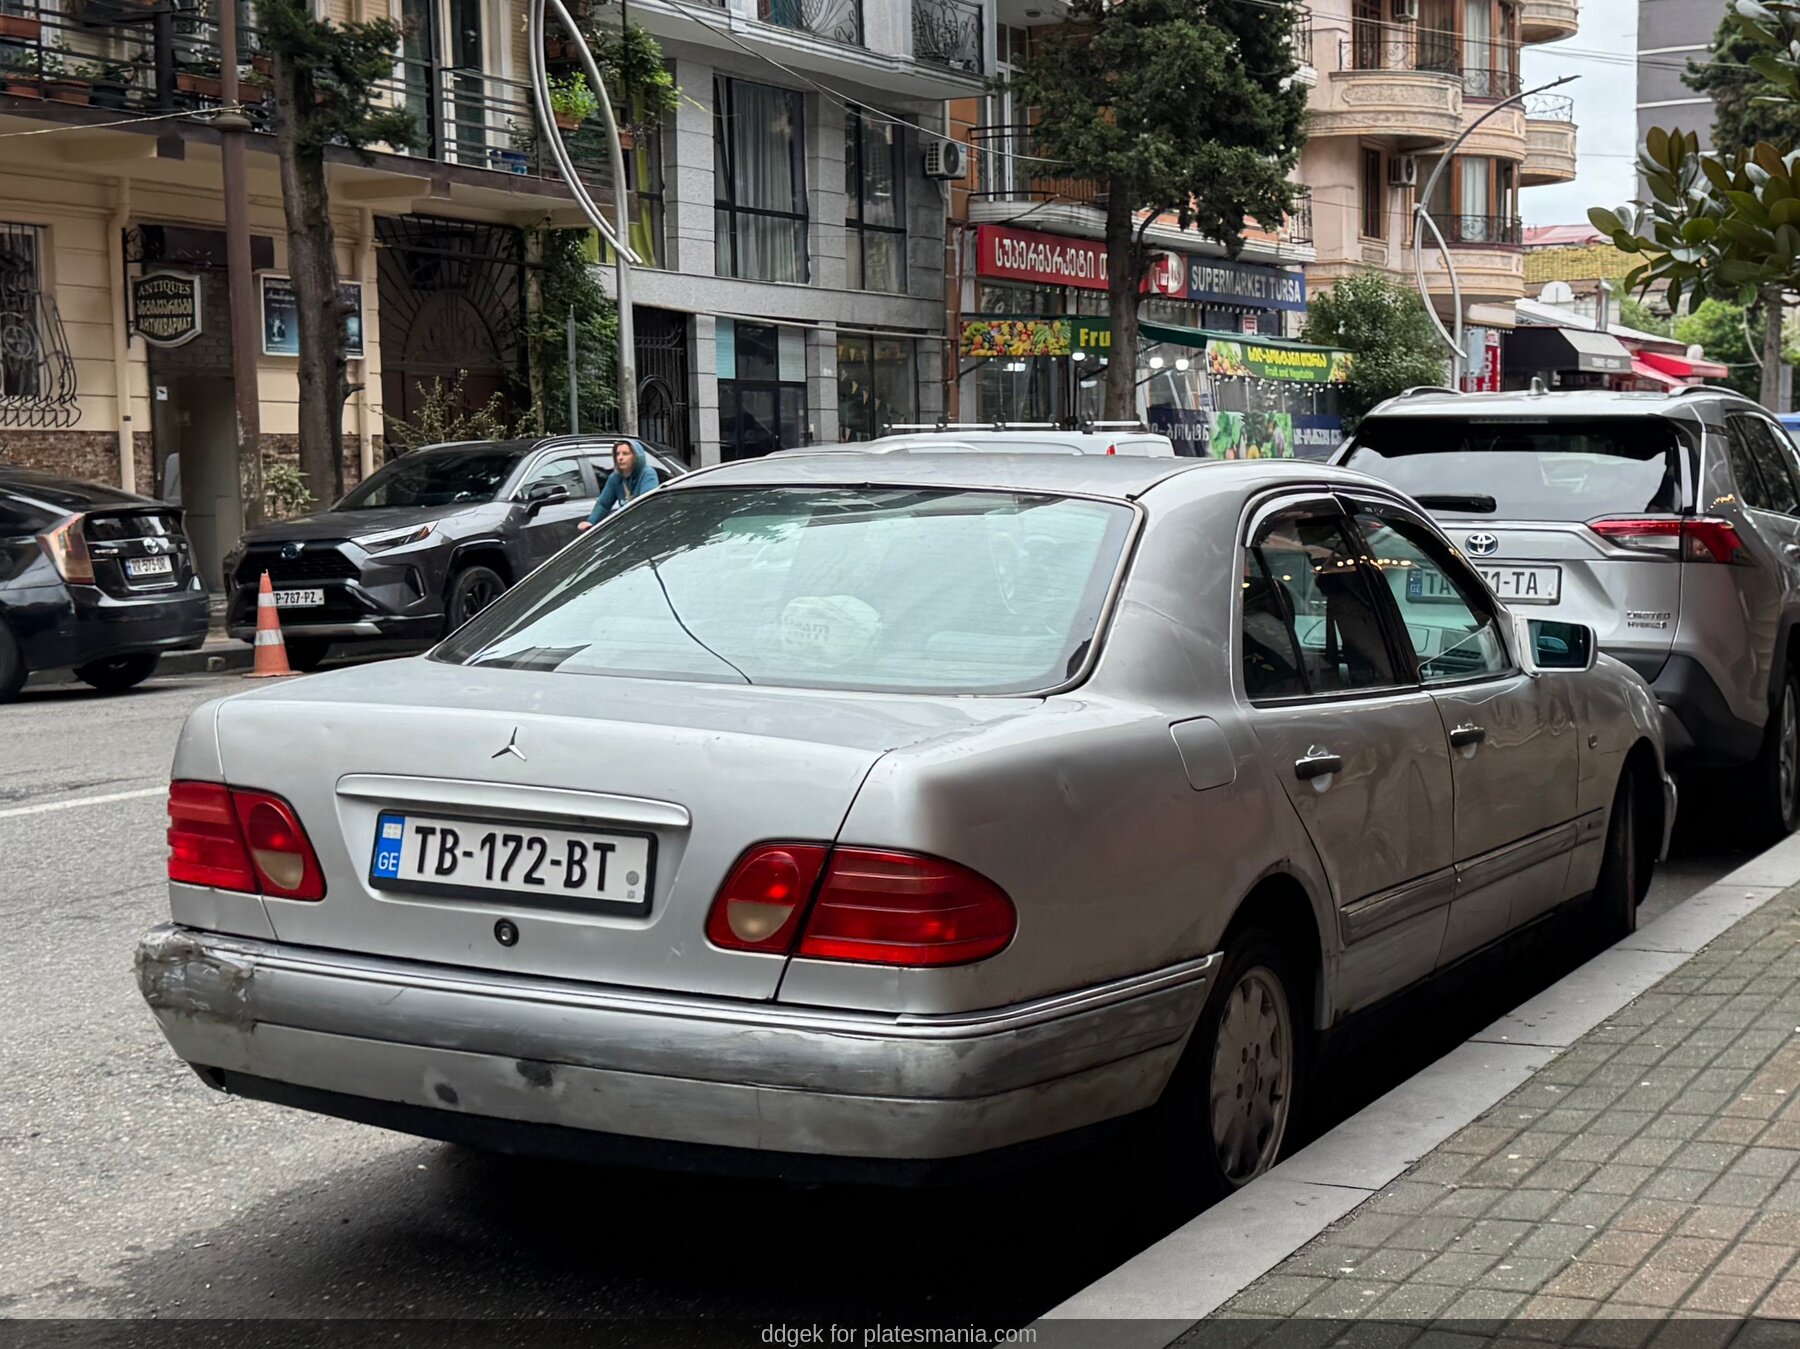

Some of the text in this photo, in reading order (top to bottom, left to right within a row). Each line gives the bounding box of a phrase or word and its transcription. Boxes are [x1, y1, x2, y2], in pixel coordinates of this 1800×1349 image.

[995, 236, 1095, 279] სუპერმარკეტი
[138, 280, 192, 296] ANTIQUES
[1191, 265, 1267, 299] SUPERMARKET
[1269, 278, 1302, 304] TURSA
[377, 825, 617, 892] GE TB-172-BT
